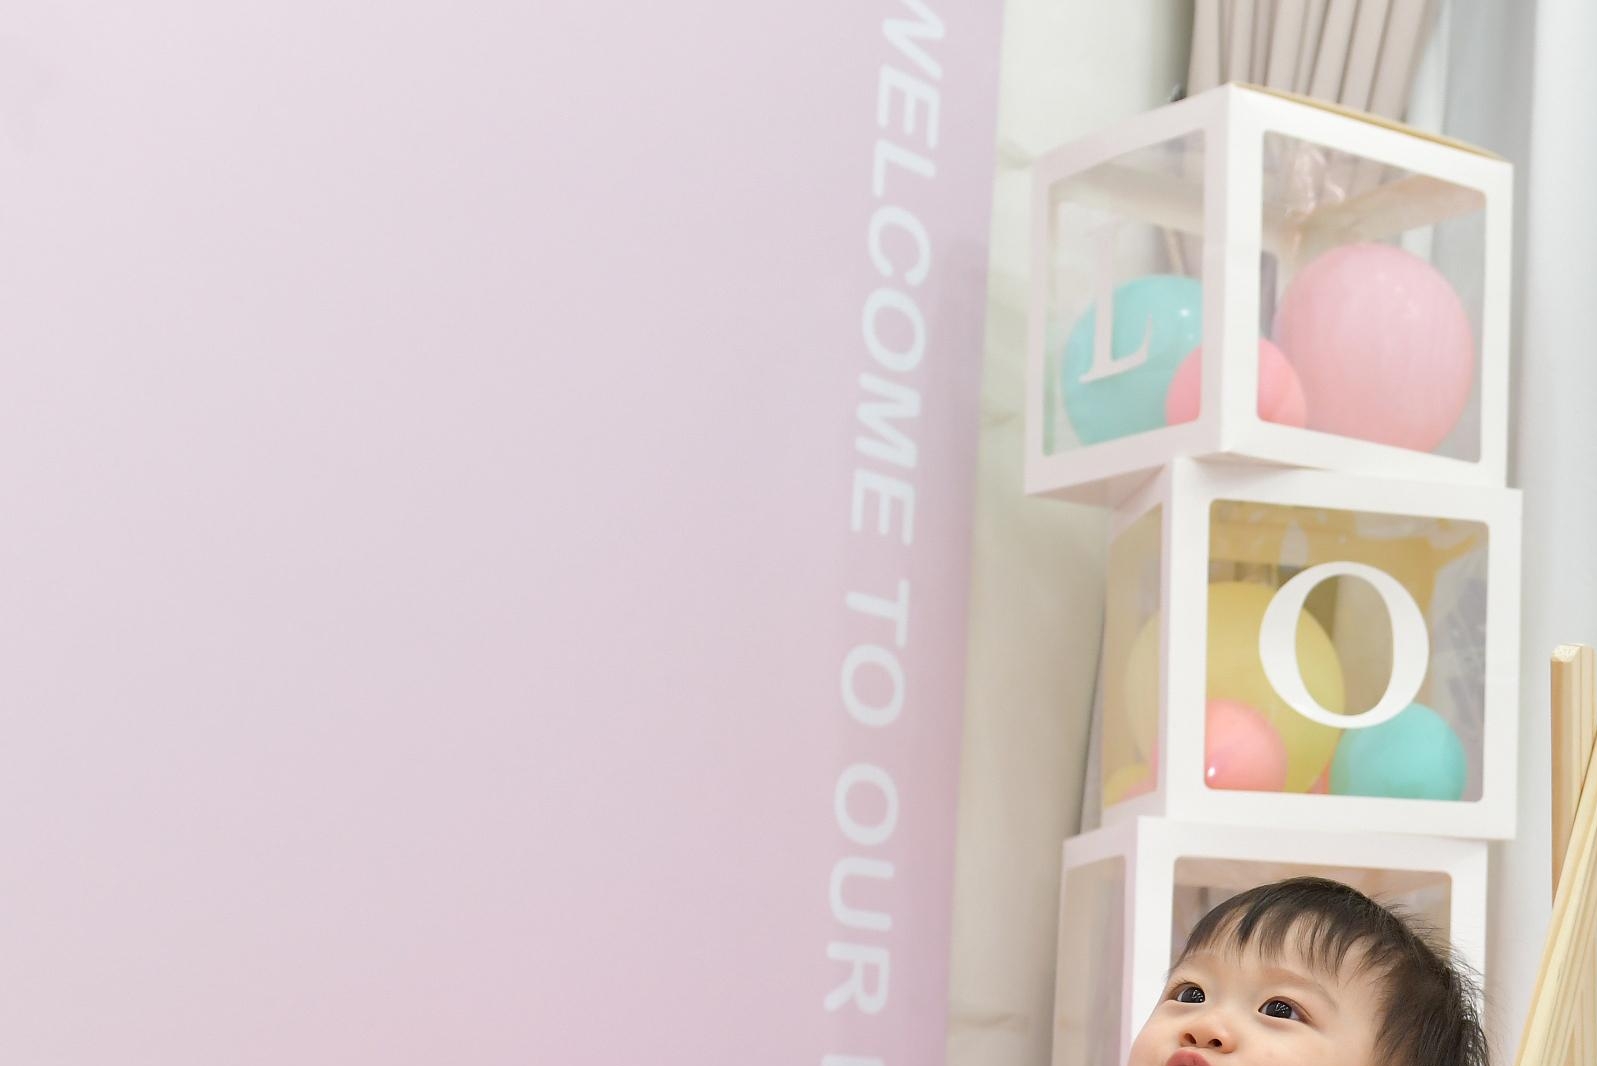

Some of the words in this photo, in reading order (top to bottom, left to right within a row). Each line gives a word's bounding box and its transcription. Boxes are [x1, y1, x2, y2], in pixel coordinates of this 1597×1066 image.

[850, 0, 945, 546] WELCOME
[1078, 214, 1154, 385] L
[840, 578, 911, 727] TO
[1258, 560, 1430, 729] O
[823, 762, 899, 1016] OUR
